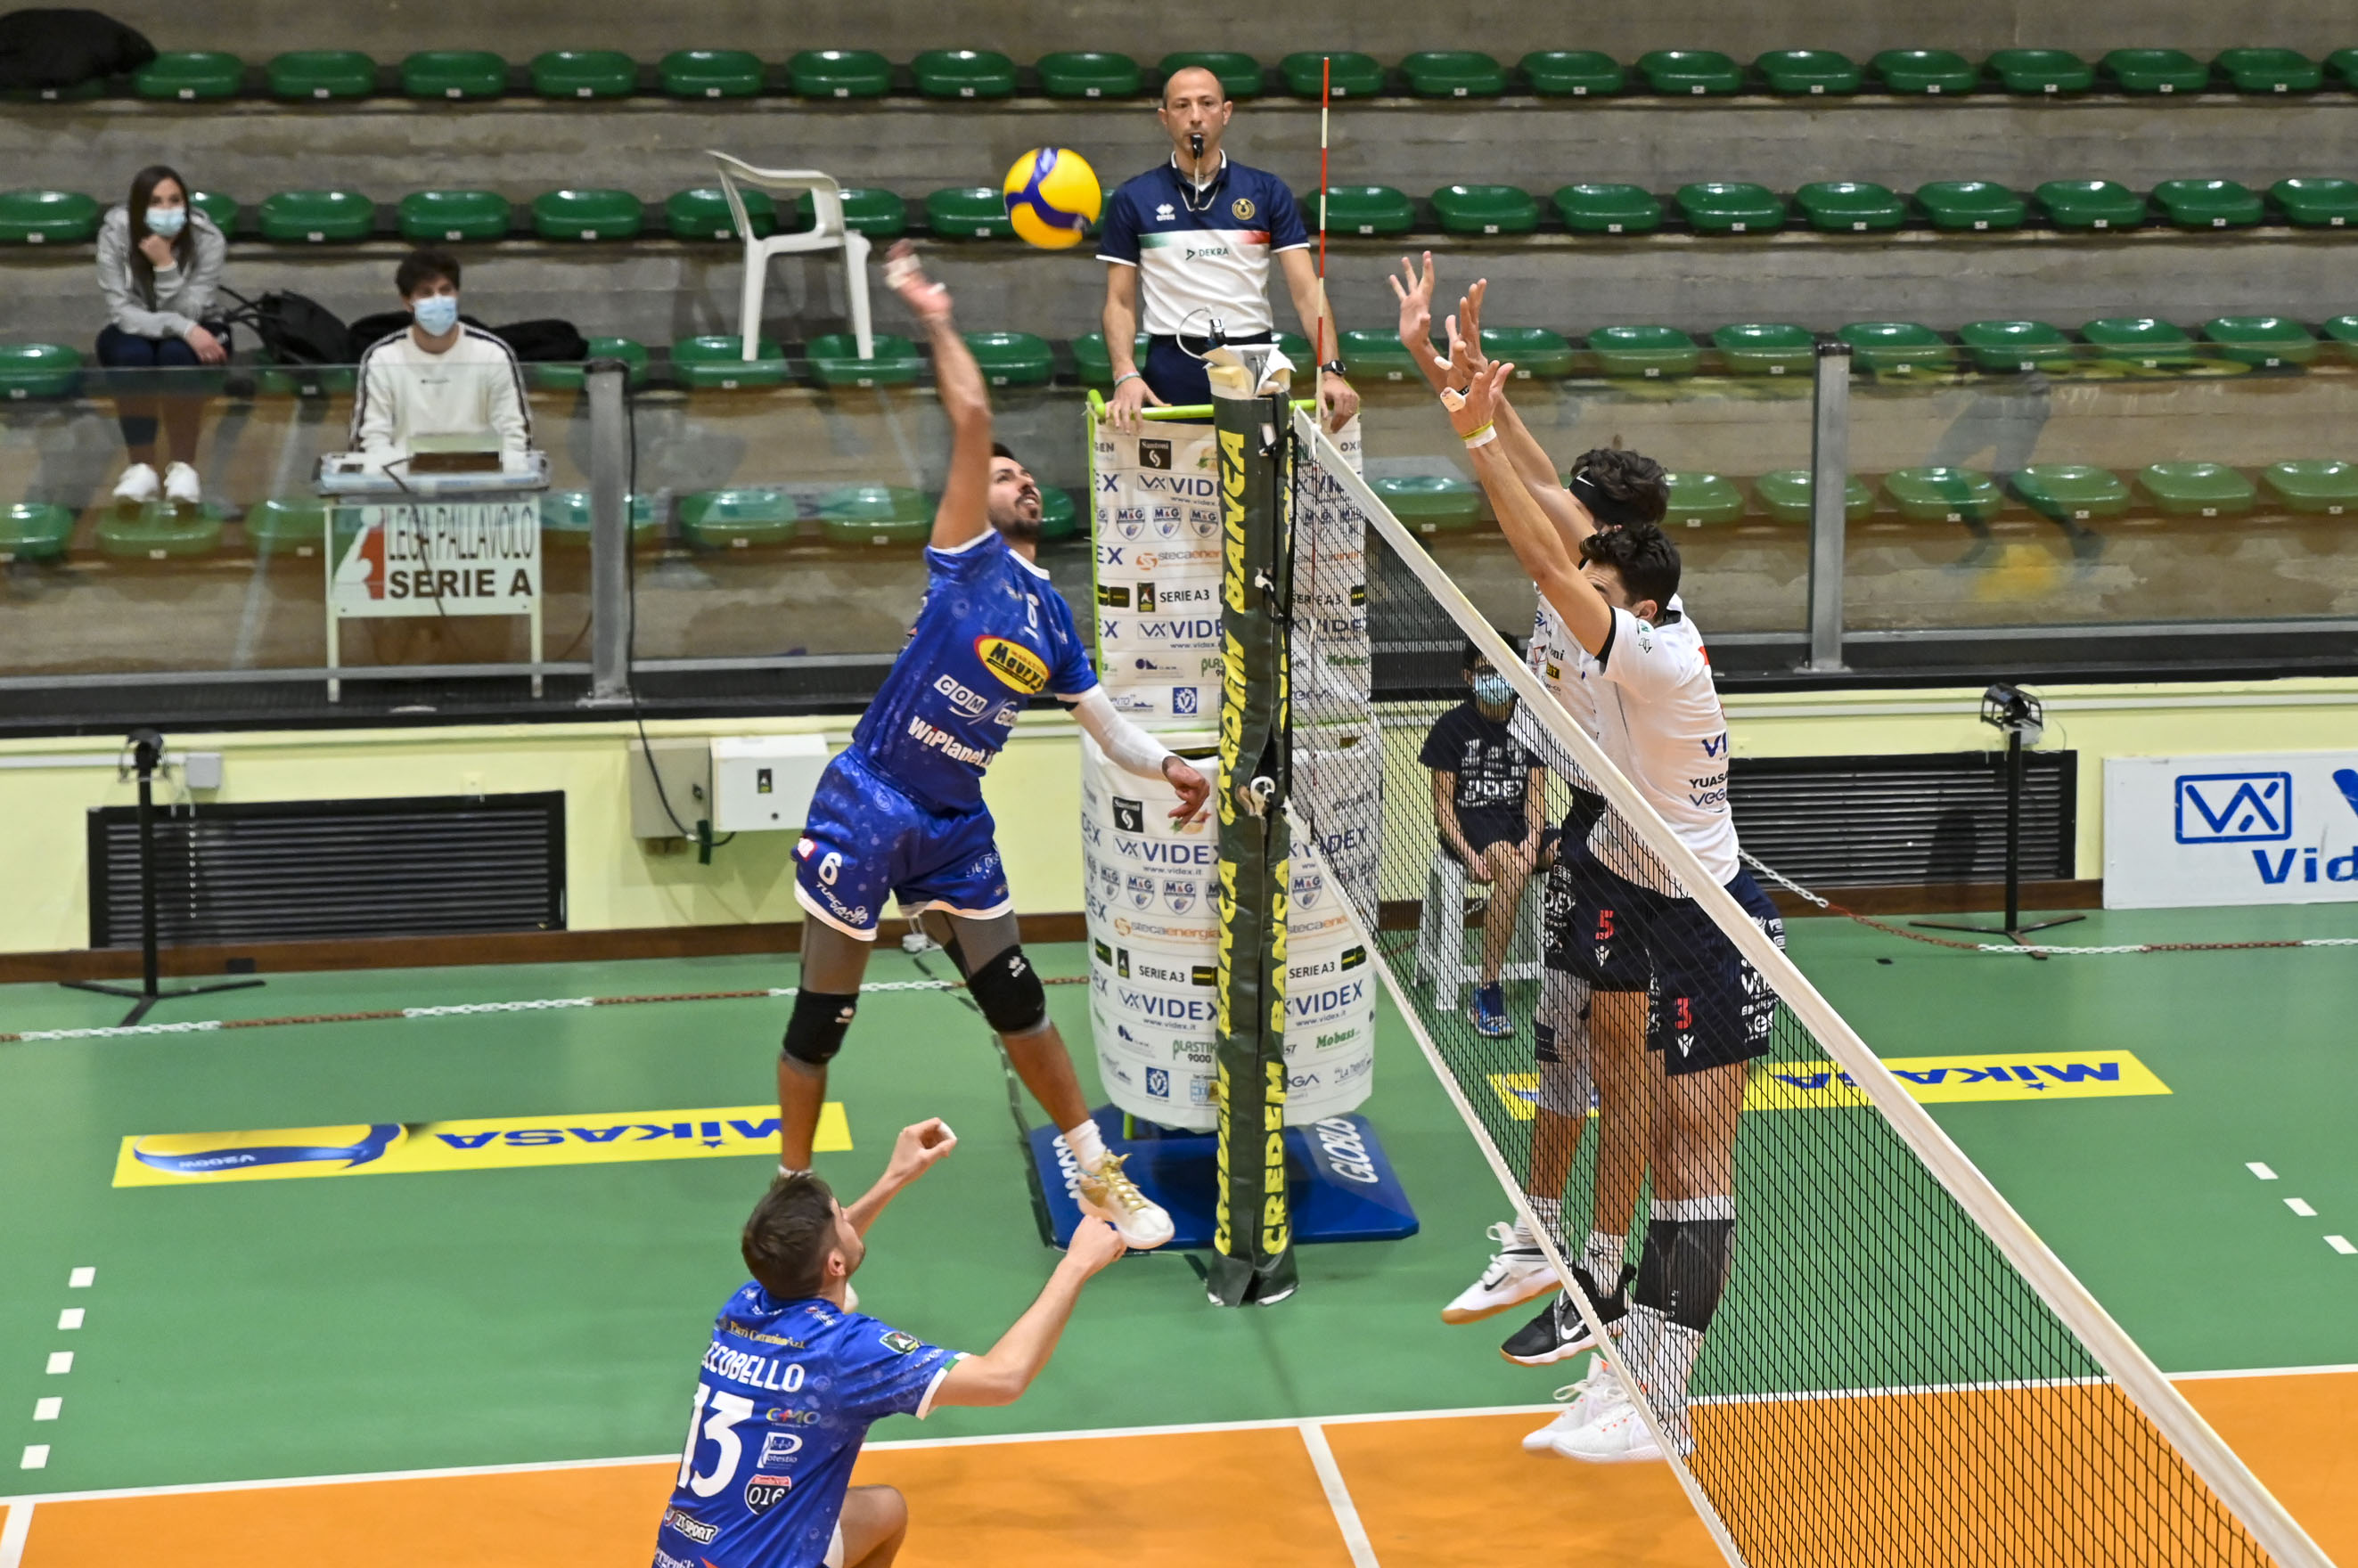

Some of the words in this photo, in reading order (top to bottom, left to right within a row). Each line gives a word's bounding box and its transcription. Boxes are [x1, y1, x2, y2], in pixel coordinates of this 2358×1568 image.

[1199, 247, 1229, 257] DEKRA
[1219, 429, 1245, 615] BANCA
[389, 569, 496, 600] SERIE
[508, 568, 533, 597] A
[1159, 591, 1191, 603] SERIE
[1194, 589, 1210, 601] A3
[818, 852, 843, 886] 6
[1594, 909, 1615, 941] 5
[1270, 859, 1289, 1033] BANCA
[1139, 965, 1167, 981] SERIE
[1168, 971, 1185, 984] A3
[1289, 964, 1319, 980] SERIE
[1322, 961, 1336, 976] A3
[1296, 979, 1363, 1017] VIDEX
[1674, 997, 1693, 1030] 3
[1187, 1053, 1212, 1064] 9000
[1263, 1060, 1287, 1256] CREDEM
[676, 1382, 755, 1499] 13
